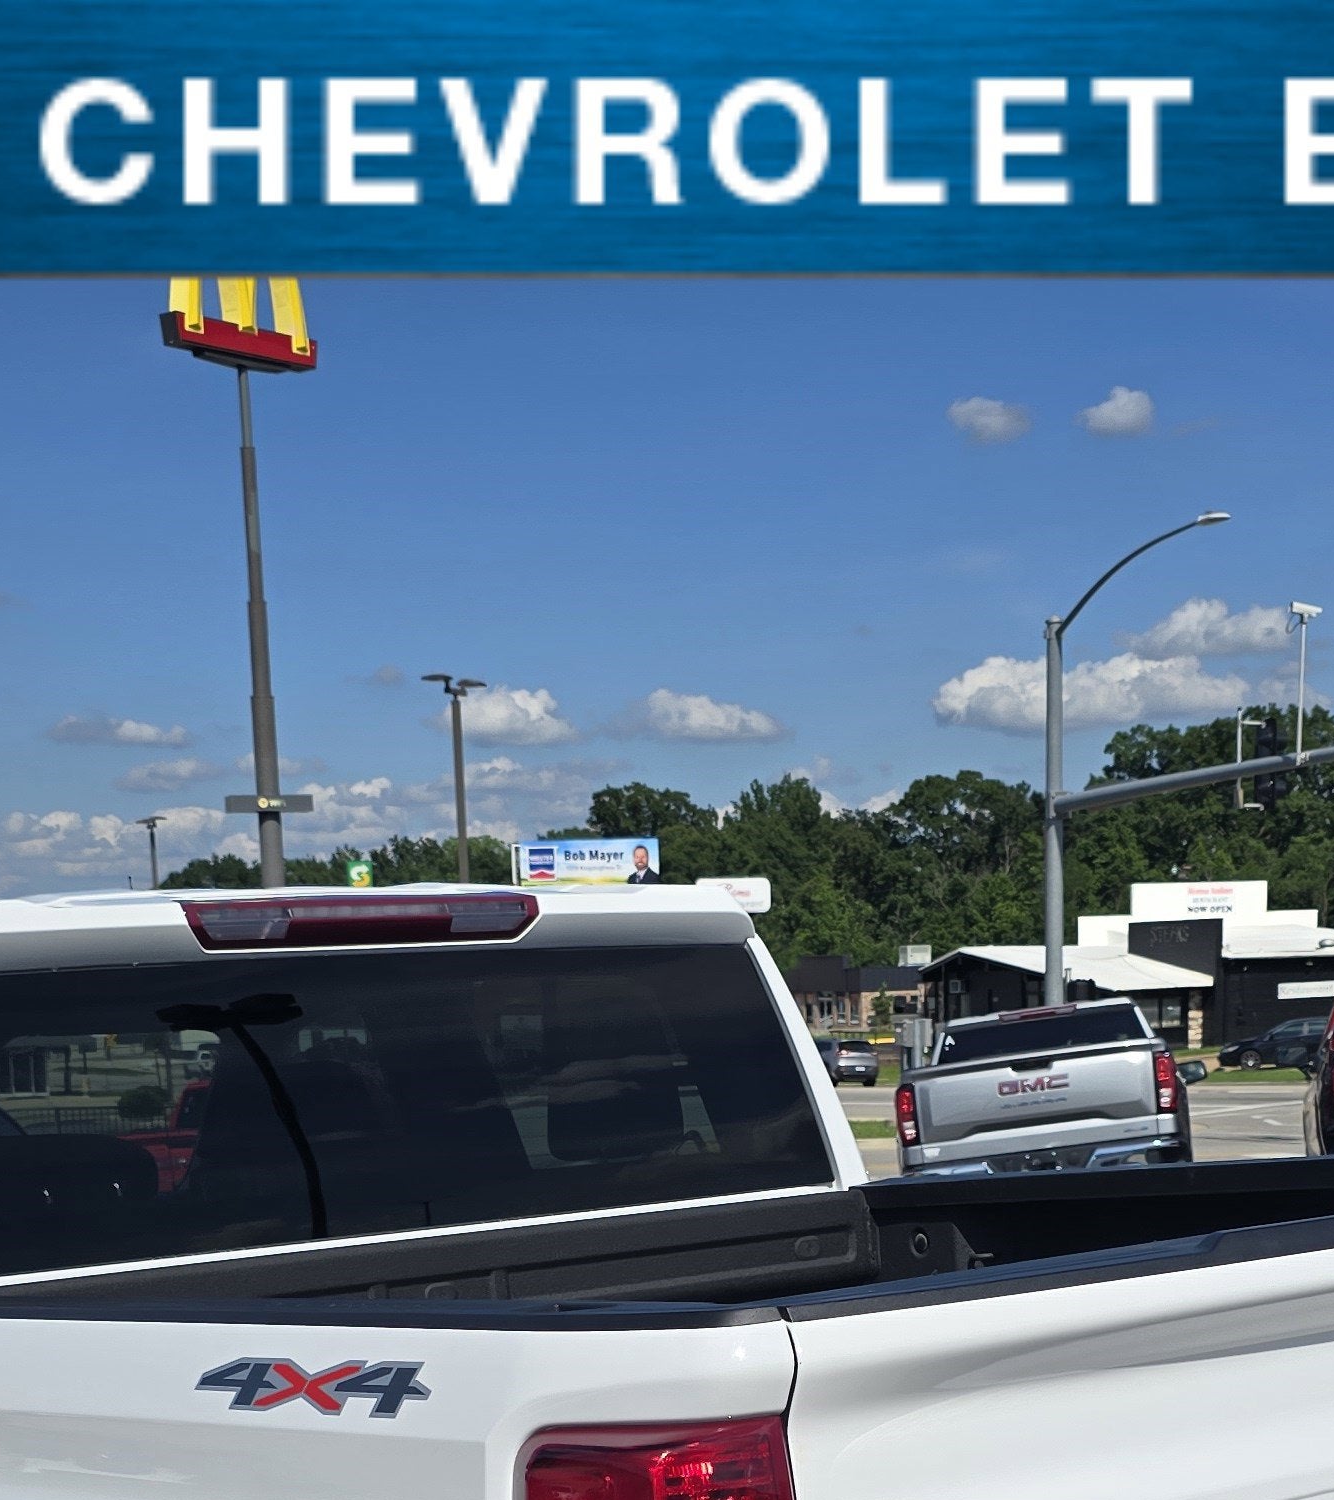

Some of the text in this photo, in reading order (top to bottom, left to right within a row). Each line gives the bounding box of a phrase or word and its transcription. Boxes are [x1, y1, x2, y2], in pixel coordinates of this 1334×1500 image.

[564, 850, 586, 861] Bob
[589, 850, 624, 863] Mayer
[1187, 904, 1233, 914] NOW OPEN
[998, 1073, 1070, 1097] GMC
